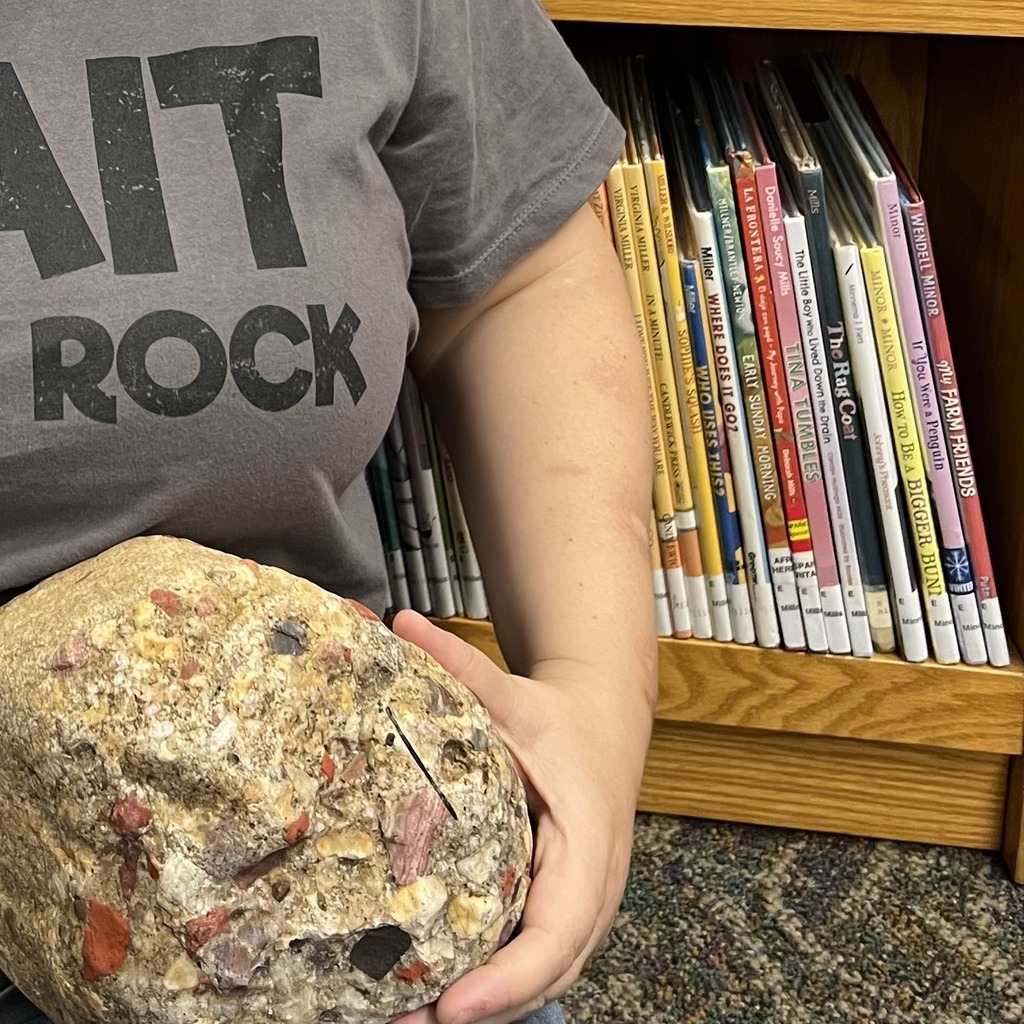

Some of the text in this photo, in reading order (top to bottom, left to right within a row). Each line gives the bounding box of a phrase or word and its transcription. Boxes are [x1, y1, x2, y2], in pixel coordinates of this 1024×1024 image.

[888, 203, 901, 239] Minor
[765, 187, 791, 296] Danielle Soucy Mills
[795, 250, 806, 269] The
[701, 247, 714, 281] Miller
[910, 213, 940, 317] WENDELL MINOR
[798, 271, 808, 296] Little
[802, 299, 812, 316] Boy
[809, 338, 820, 365] Lived
[827, 321, 843, 359] The
[912, 340, 922, 349] If
[32, 302, 367, 424] ROCK
[708, 294, 738, 432] WHERE DOES IT GO?
[786, 343, 804, 392] TINA
[834, 363, 850, 397] Rag
[913, 352, 928, 380] You
[813, 369, 823, 397] Down
[921, 384, 930, 407] Were
[742, 354, 776, 501] EARLY SUNDAY MORNING
[820, 417, 830, 444] Drain
[839, 400, 856, 440] Coat
[937, 361, 975, 497] My FARM FRIENDS
[794, 398, 819, 481] TUMBLES
[928, 421, 943, 471] Penguin
[908, 478, 931, 547] BIGGER
